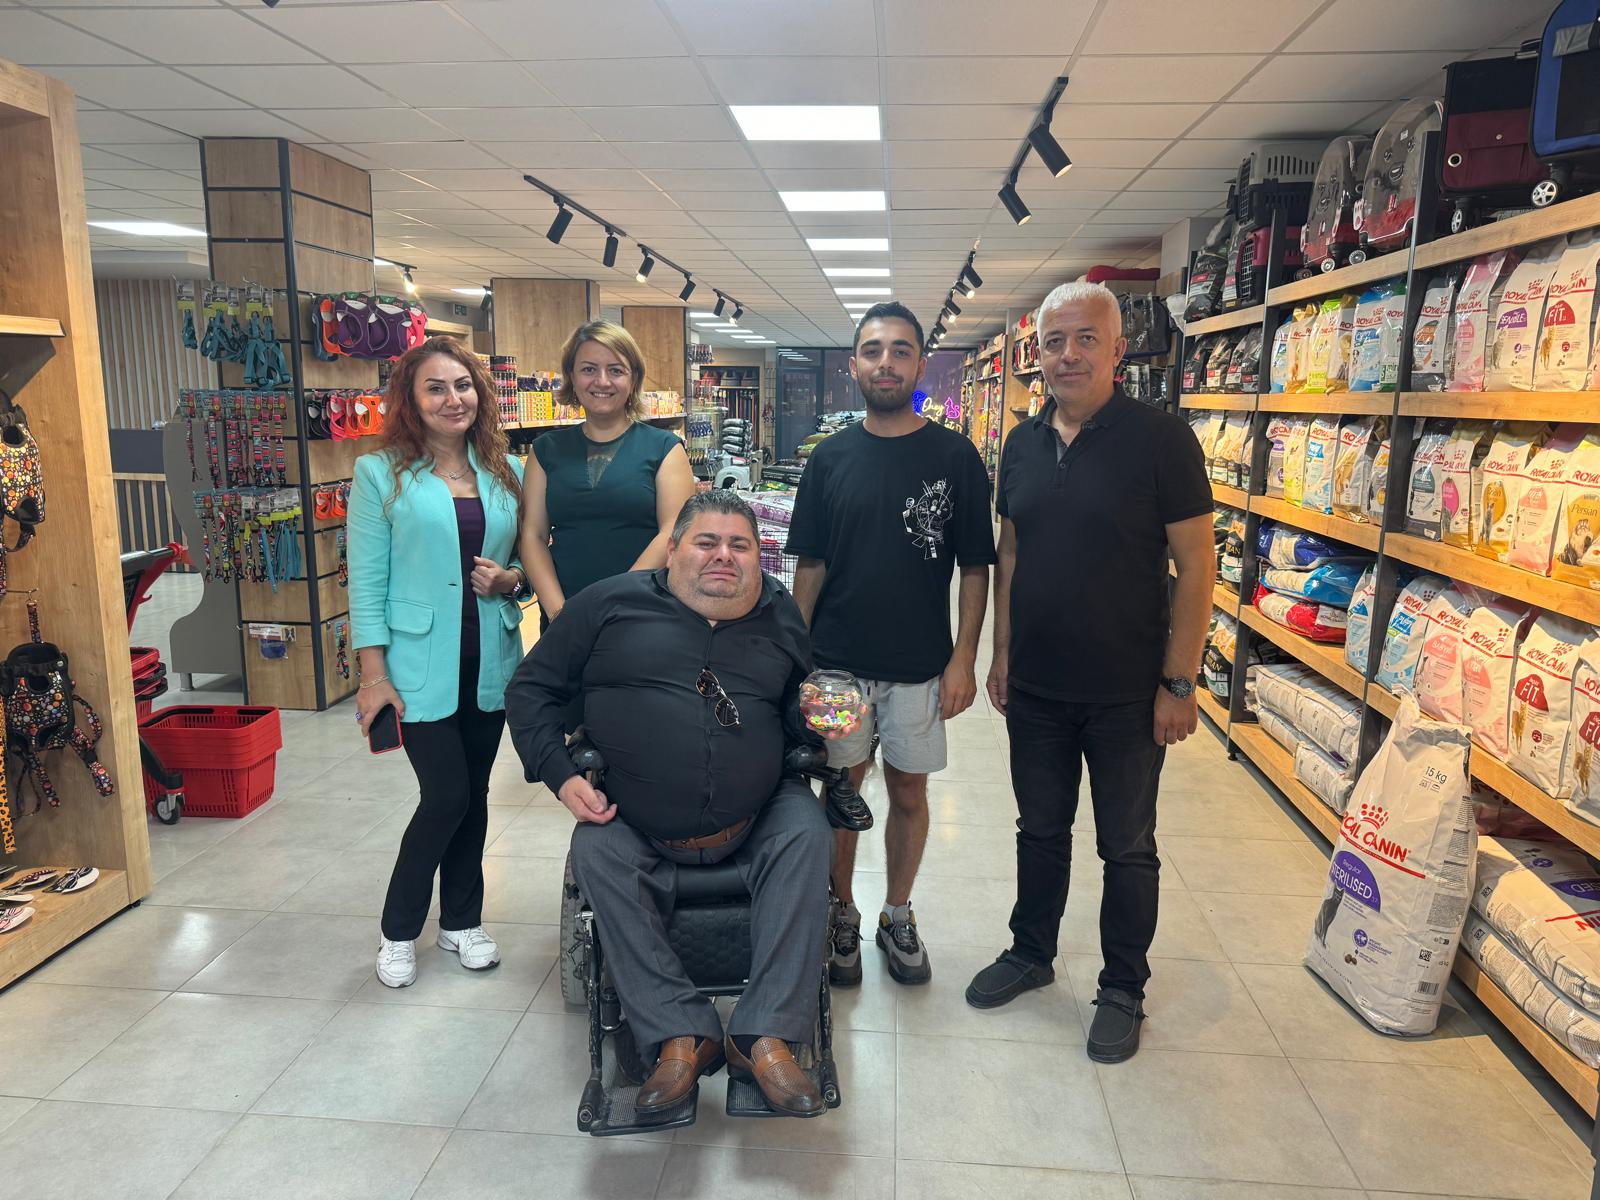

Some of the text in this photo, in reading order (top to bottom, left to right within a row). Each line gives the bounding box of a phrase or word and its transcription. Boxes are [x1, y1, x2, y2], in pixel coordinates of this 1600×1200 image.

[1571, 503, 1598, 517] Persian
[1437, 610, 1463, 628] ROYAL
[1470, 631, 1496, 654] ROYAL
[1520, 682, 1540, 702] FIT
[1425, 766, 1447, 784] 15 kg
[1362, 831, 1409, 863] CANIN
